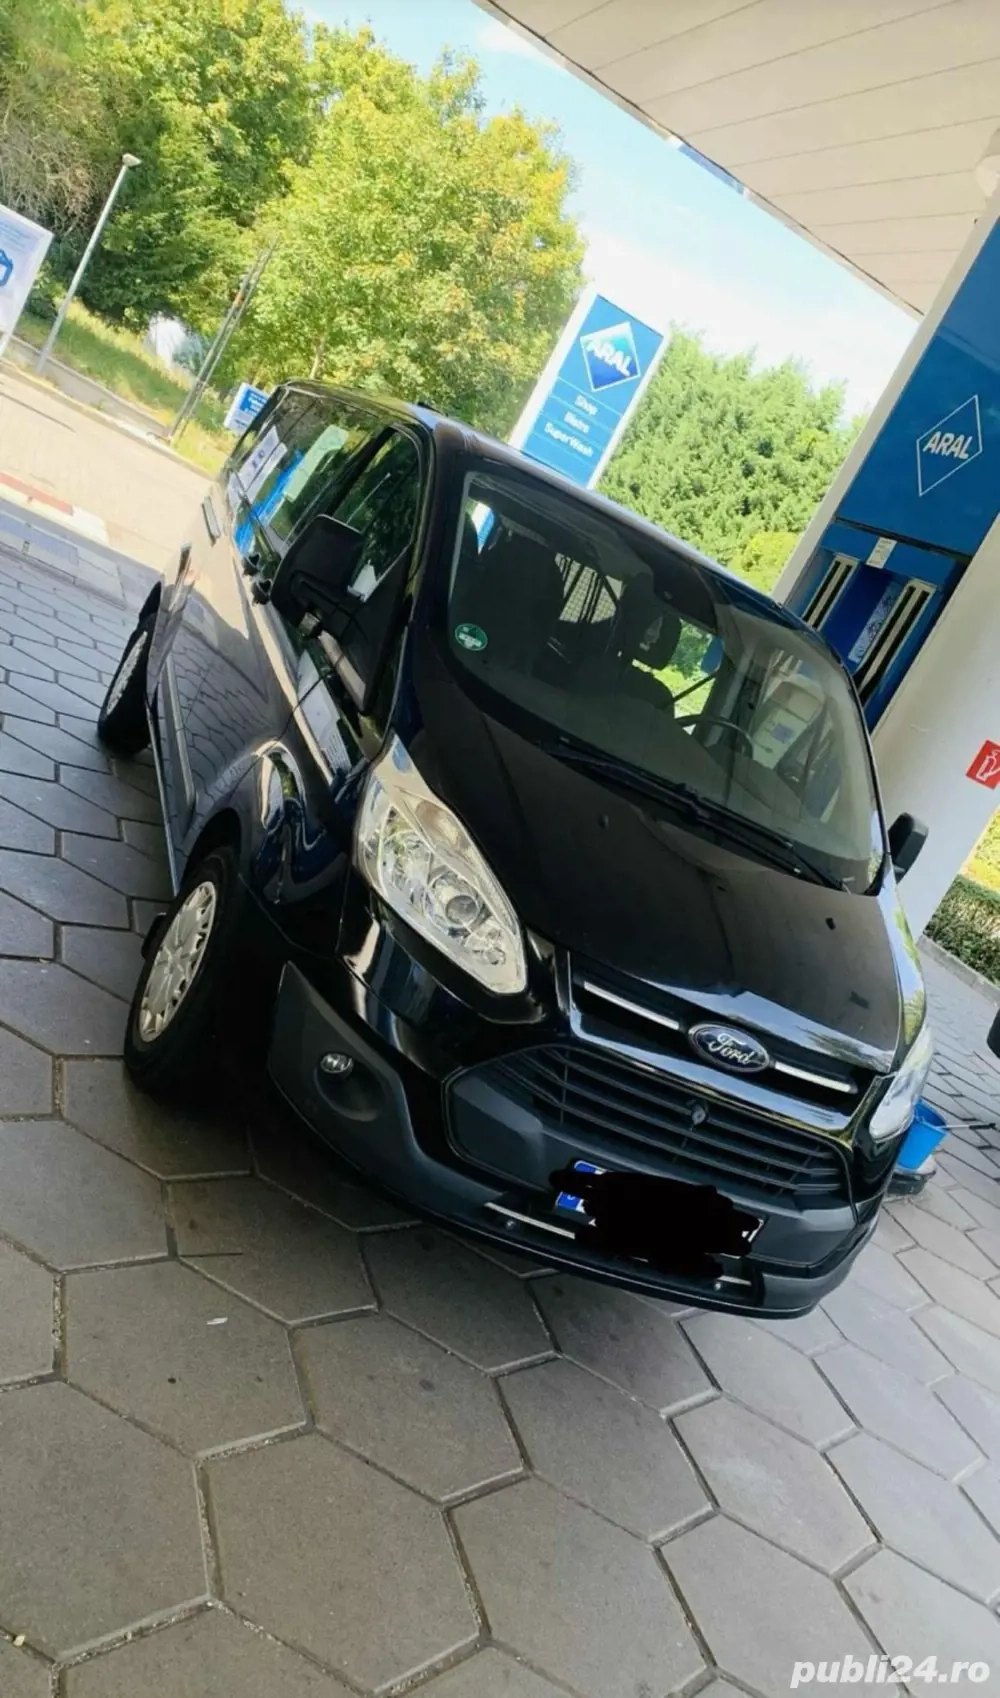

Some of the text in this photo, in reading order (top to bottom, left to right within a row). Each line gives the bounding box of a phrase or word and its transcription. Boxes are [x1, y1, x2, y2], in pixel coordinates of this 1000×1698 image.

[585, 340, 632, 377] ARAL
[574, 394, 598, 416] Shop
[544, 421, 594, 457] SuperWash
[922, 431, 973, 459] ARAL
[708, 1032, 755, 1065] Ford
